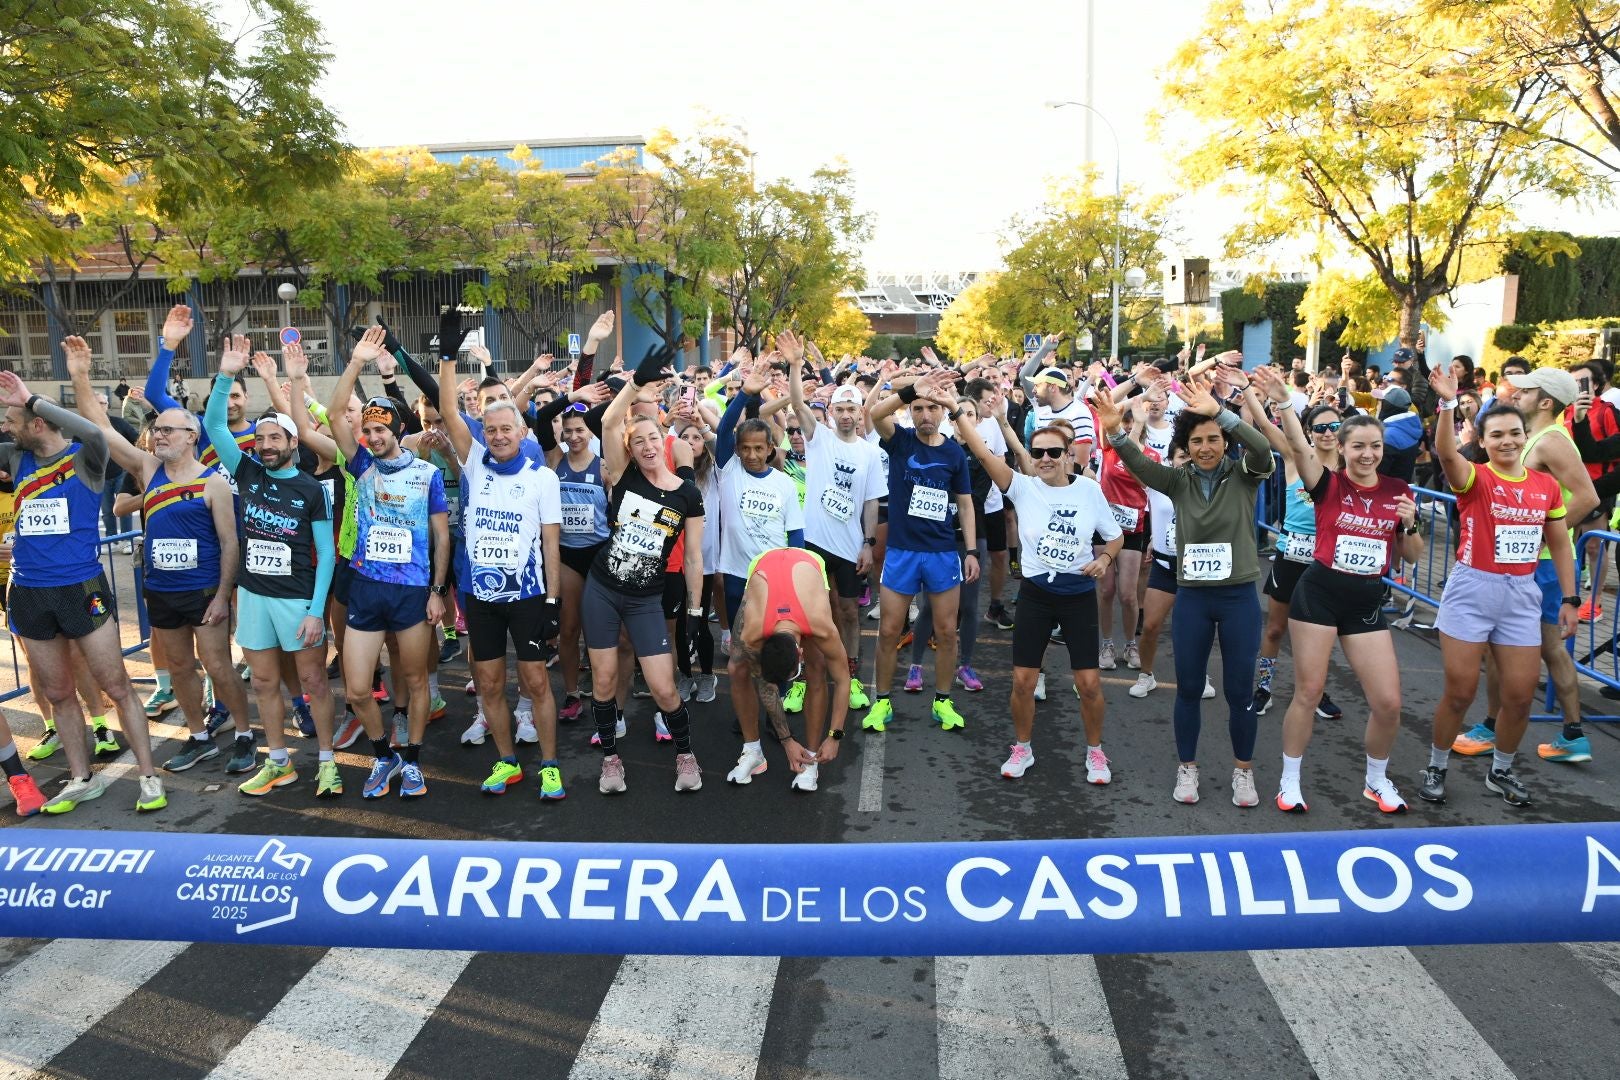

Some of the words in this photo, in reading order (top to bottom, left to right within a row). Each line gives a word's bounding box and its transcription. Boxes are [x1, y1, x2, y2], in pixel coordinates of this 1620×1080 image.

[560, 487, 595, 495] RGENTINA
[746, 499, 774, 512] 1909
[826, 498, 848, 514] 1746
[915, 499, 944, 513] 2059
[28, 514, 57, 526] 1961
[246, 503, 299, 529] MADRID
[476, 507, 522, 522] ATLETISMO
[562, 516, 588, 526] 1856
[1112, 511, 1133, 526] 098
[1336, 511, 1395, 530] ISBILYA
[476, 518, 520, 534] APOLANA
[1047, 522, 1077, 536] CAN
[1334, 521, 1385, 536] TRIATHLON
[374, 542, 402, 554] 1981
[626, 532, 655, 551] 1946
[1343, 540, 1382, 550] CASTILLOS
[1504, 542, 1535, 554] 1873
[159, 553, 188, 563] 1910
[481, 547, 509, 559] 1701
[1042, 545, 1075, 562] 2056
[1293, 546, 1314, 558] 156
[254, 555, 282, 567] 1773
[1191, 560, 1222, 572] 1712
[1343, 552, 1376, 568] 1872
[203, 854, 255, 863] ALICANTE
[185, 864, 265, 879] CARRERA
[266, 872, 278, 880] DE
[280, 873, 298, 881] LOS
[322, 853, 746, 922] CARRERA
[762, 887, 821, 922] DE
[839, 886, 927, 922] LOS
[945, 844, 1473, 922] CASTILLOS
[63, 883, 112, 908] Car
[176, 882, 292, 903] CASTILLOS
[211, 905, 248, 920] 2025
